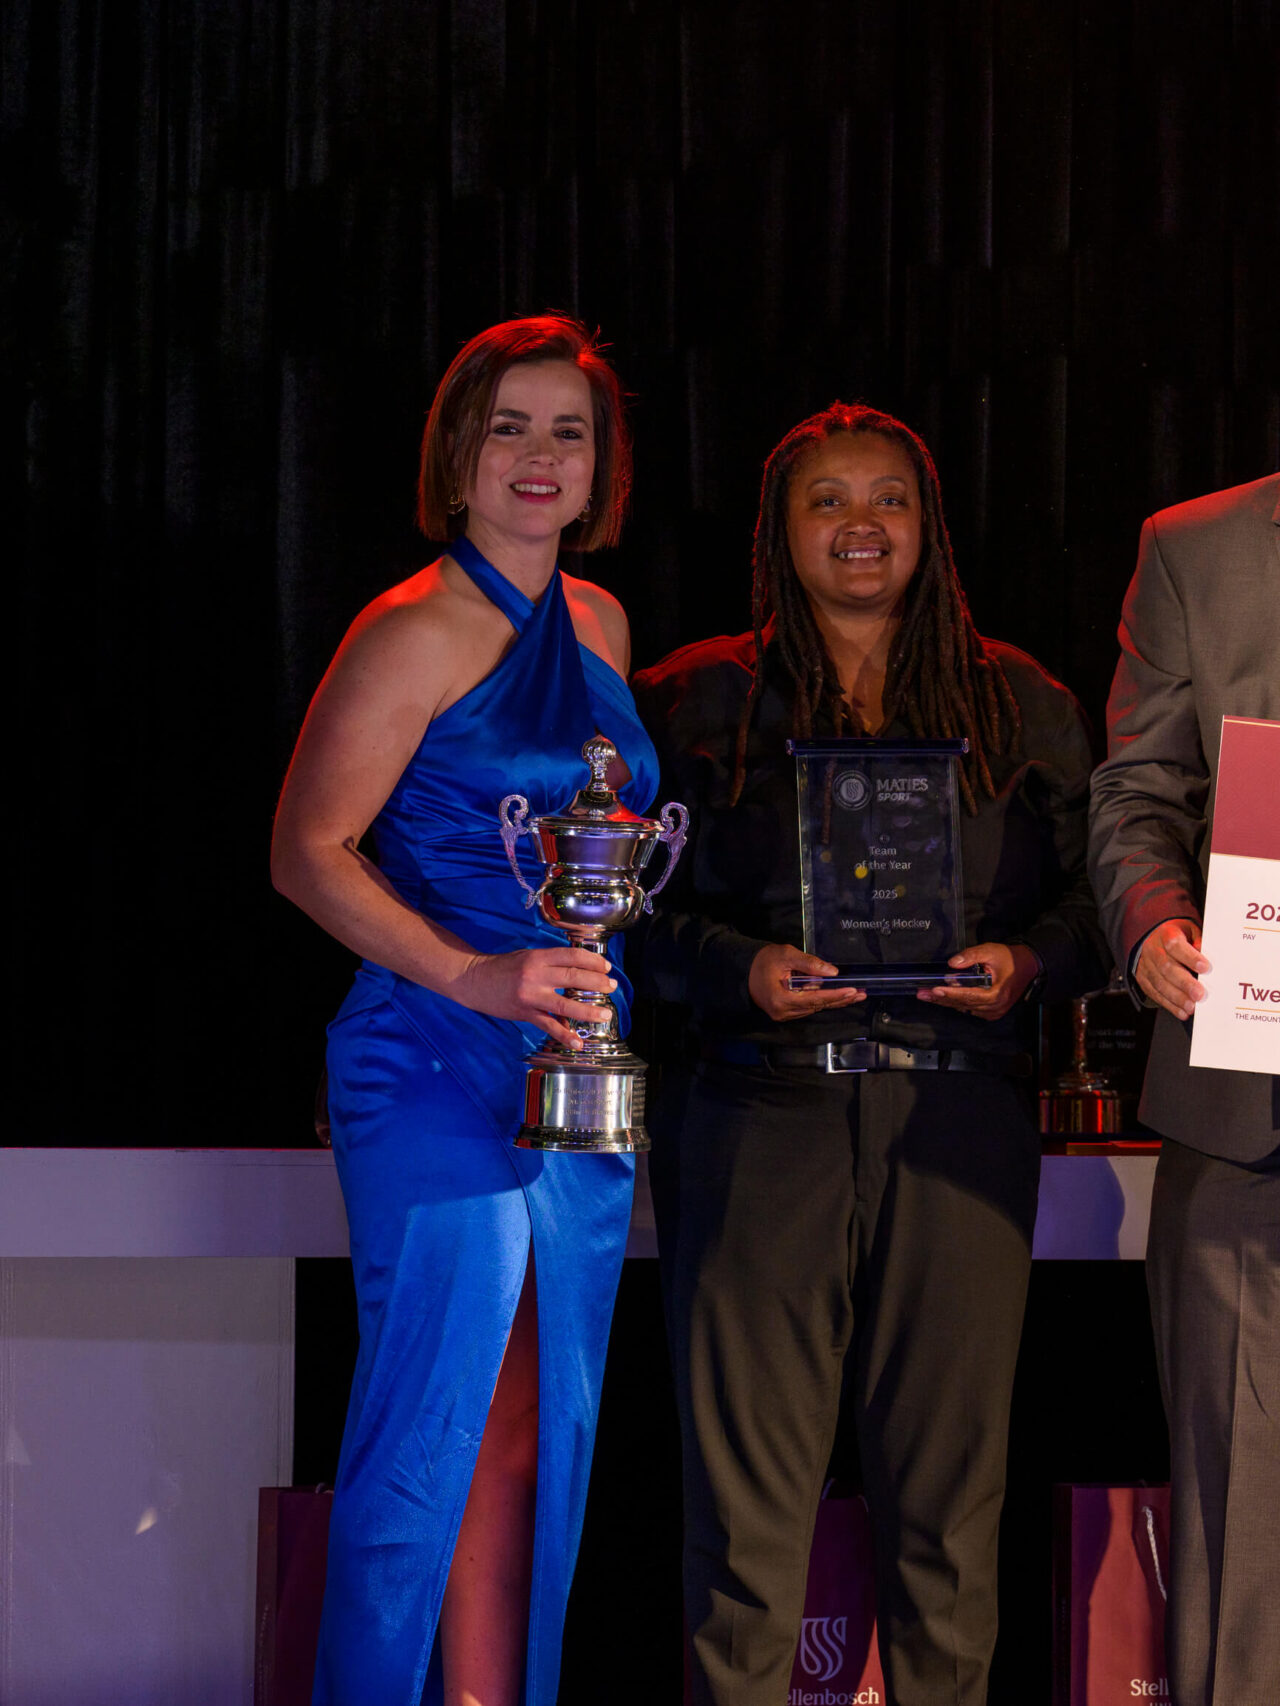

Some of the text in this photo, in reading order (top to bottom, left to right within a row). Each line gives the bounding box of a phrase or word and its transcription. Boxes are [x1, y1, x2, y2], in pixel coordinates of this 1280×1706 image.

[876, 778, 928, 793] MATIES
[878, 793, 911, 802] SPORT
[869, 846, 897, 856] Team
[868, 861, 887, 870] the
[889, 860, 912, 870] Year
[872, 889, 898, 899] 2025
[842, 918, 931, 930] Women's Hockey
[1242, 933, 1256, 941] PAY
[1235, 1012, 1249, 1021] THE
[787, 1687, 880, 1706] ellenbosch
